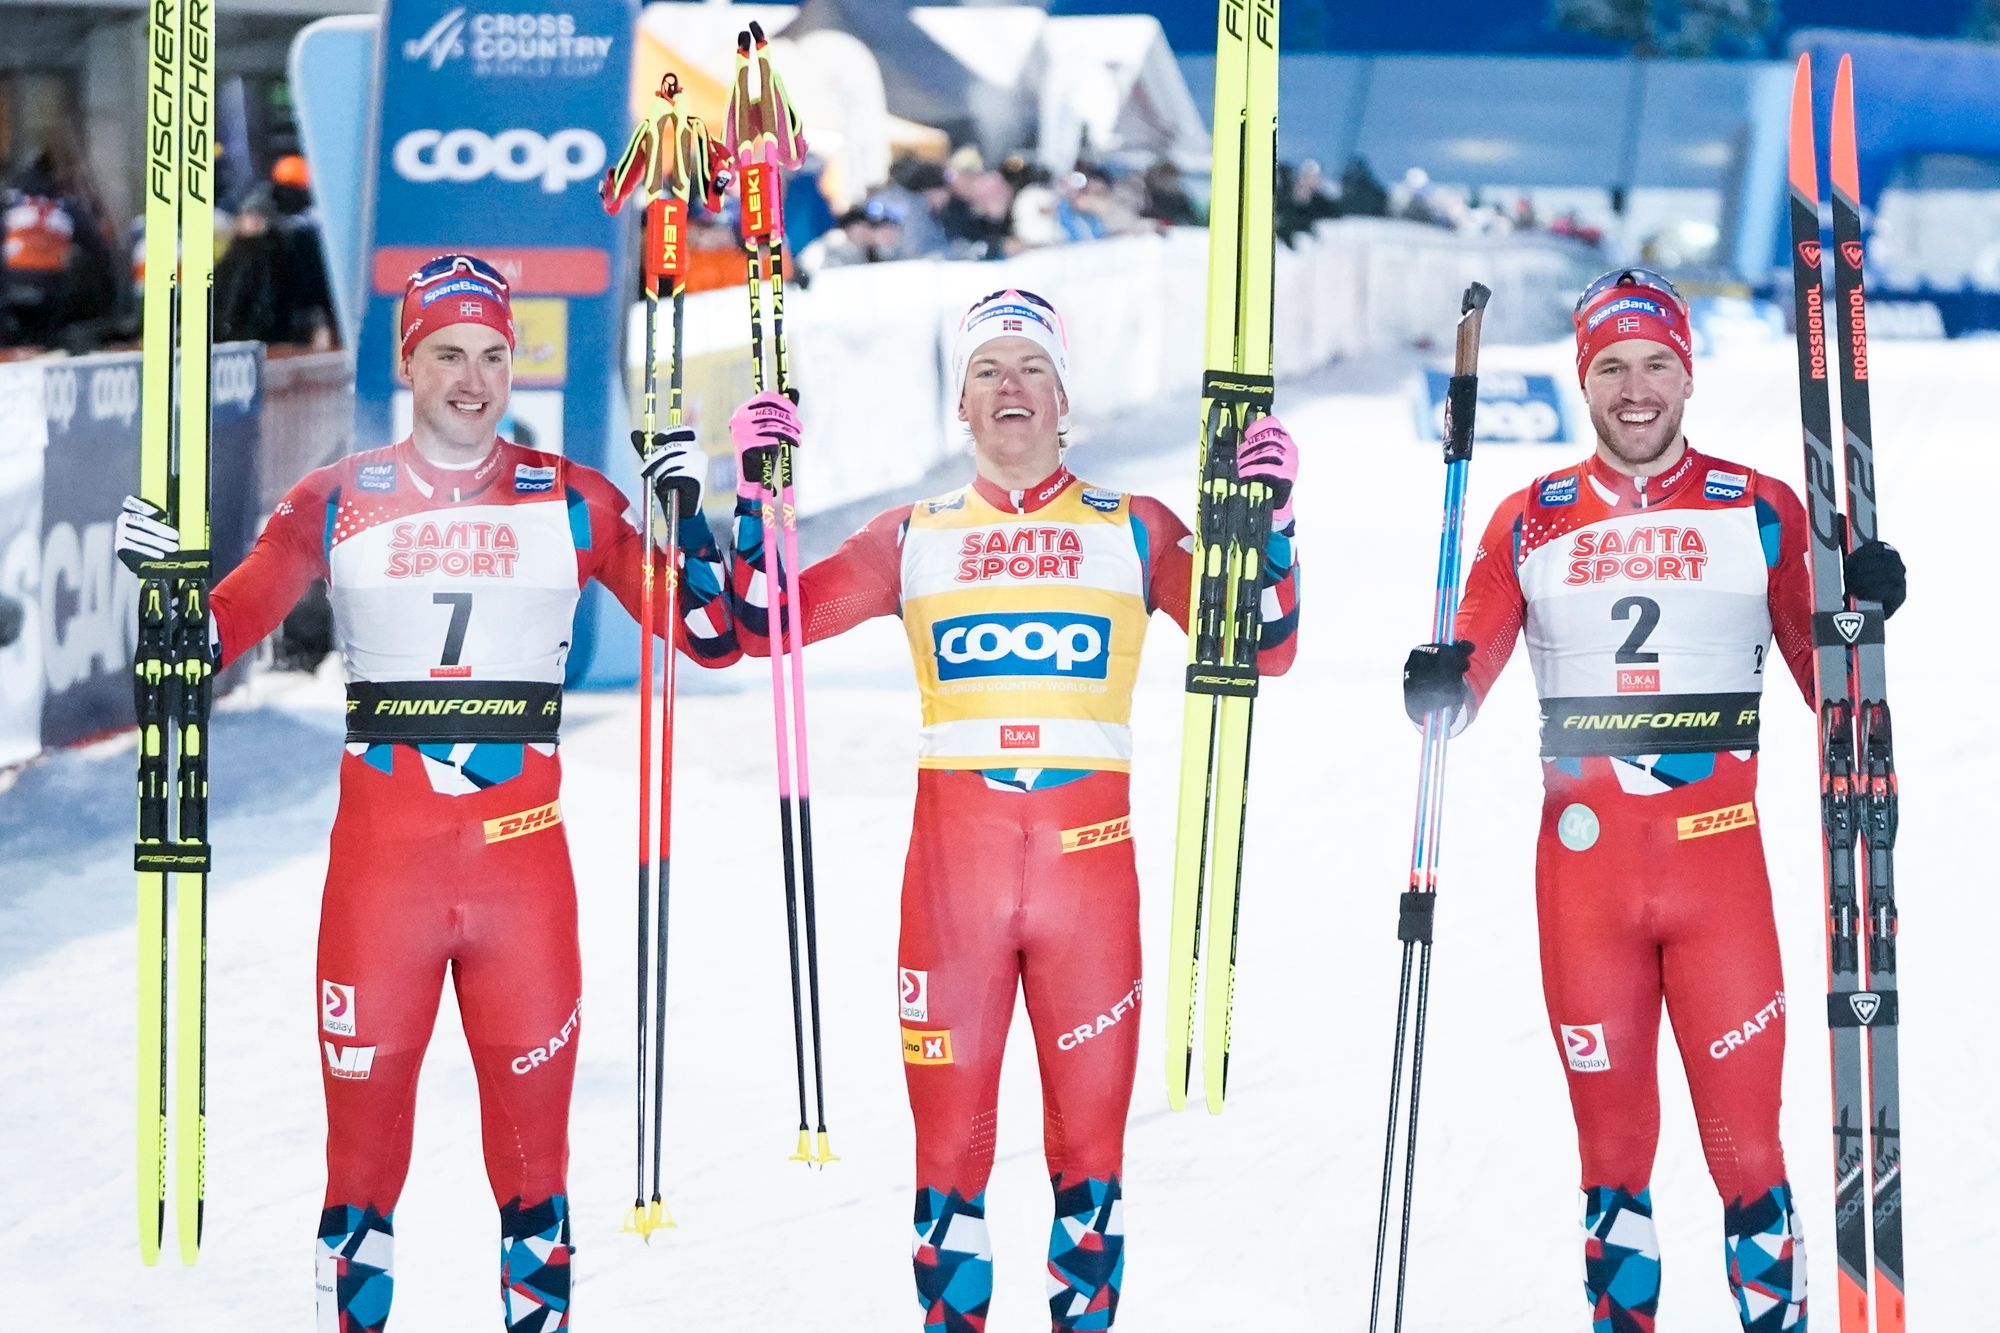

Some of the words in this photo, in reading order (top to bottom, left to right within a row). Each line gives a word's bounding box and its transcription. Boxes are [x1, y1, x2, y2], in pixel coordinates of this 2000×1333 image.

[470, 13, 576, 37] CROSS
[469, 35, 614, 61] COUNTRY
[152, 0, 174, 205] FISCHER
[188, 0, 208, 204] FISCHER
[393, 128, 607, 194] coop
[747, 167, 762, 231] LEKI
[663, 205, 678, 270] LEKI
[422, 280, 494, 303] SpareBank
[1588, 299, 1656, 328] SpareBank
[1807, 283, 1826, 380] ROSSIGNOL
[1850, 283, 1869, 381] ROSSIGNOL
[1207, 380, 1274, 395] FISCHER
[362, 481, 391, 490] coop
[516, 482, 553, 490] coop
[1545, 477, 1575, 492] MINI
[1661, 461, 1691, 488] CRAFT
[1545, 494, 1573, 502] coop
[1705, 486, 1743, 499] coop
[387, 521, 520, 551] SANTA
[958, 527, 1084, 557] SANTA
[1570, 525, 1708, 558] SANTA
[140, 561, 210, 569] FISCHER
[384, 550, 521, 580] SPORT
[954, 554, 1084, 583] SPORT
[1563, 555, 1709, 586] SPORT
[432, 592, 473, 666] 7
[1610, 595, 1661, 664] 2
[938, 621, 1102, 671] coop
[1192, 675, 1257, 687] FISCHER
[499, 806, 558, 837] DHL
[1691, 808, 1748, 834] DHL
[137, 854, 208, 864] FISCHER
[1057, 990, 1136, 1052] CRAFT
[1709, 1000, 1779, 1060] CRAFT
[511, 1013, 581, 1076] CRAFT
[1569, 1057, 1607, 1070] viaplay
